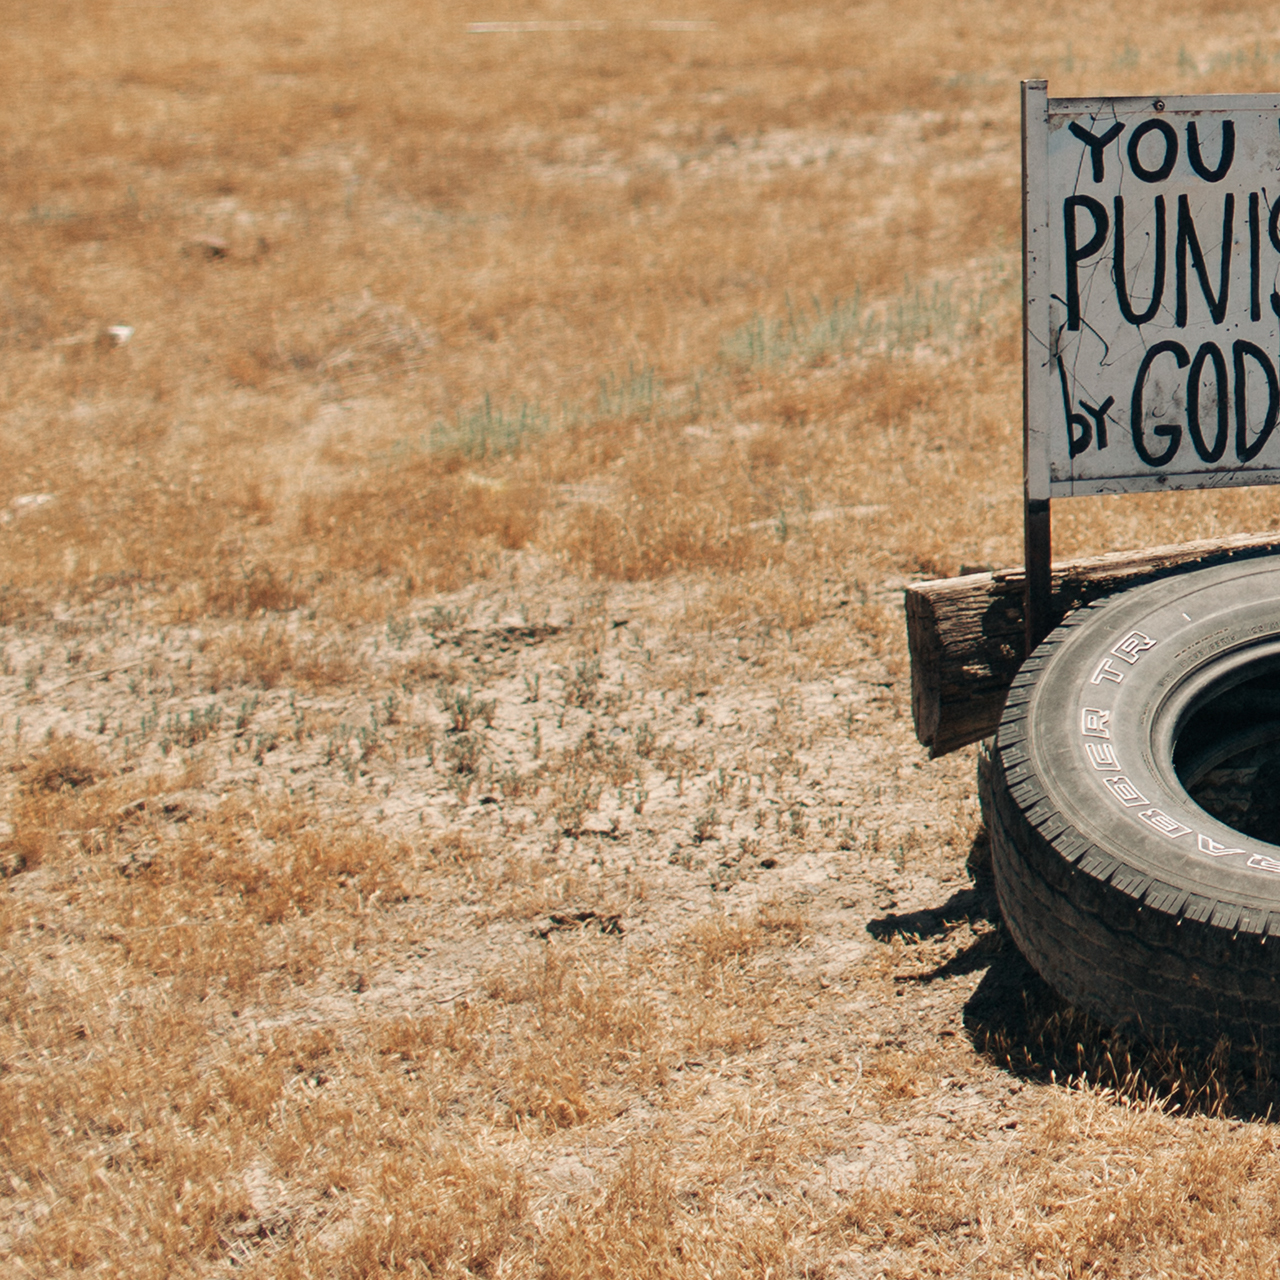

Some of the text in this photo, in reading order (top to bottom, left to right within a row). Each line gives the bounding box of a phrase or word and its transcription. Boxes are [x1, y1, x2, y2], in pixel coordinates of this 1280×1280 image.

[1069, 118, 1236, 183] YOU
[1130, 339, 1280, 467] GOD
[1089, 630, 1157, 685] TR
